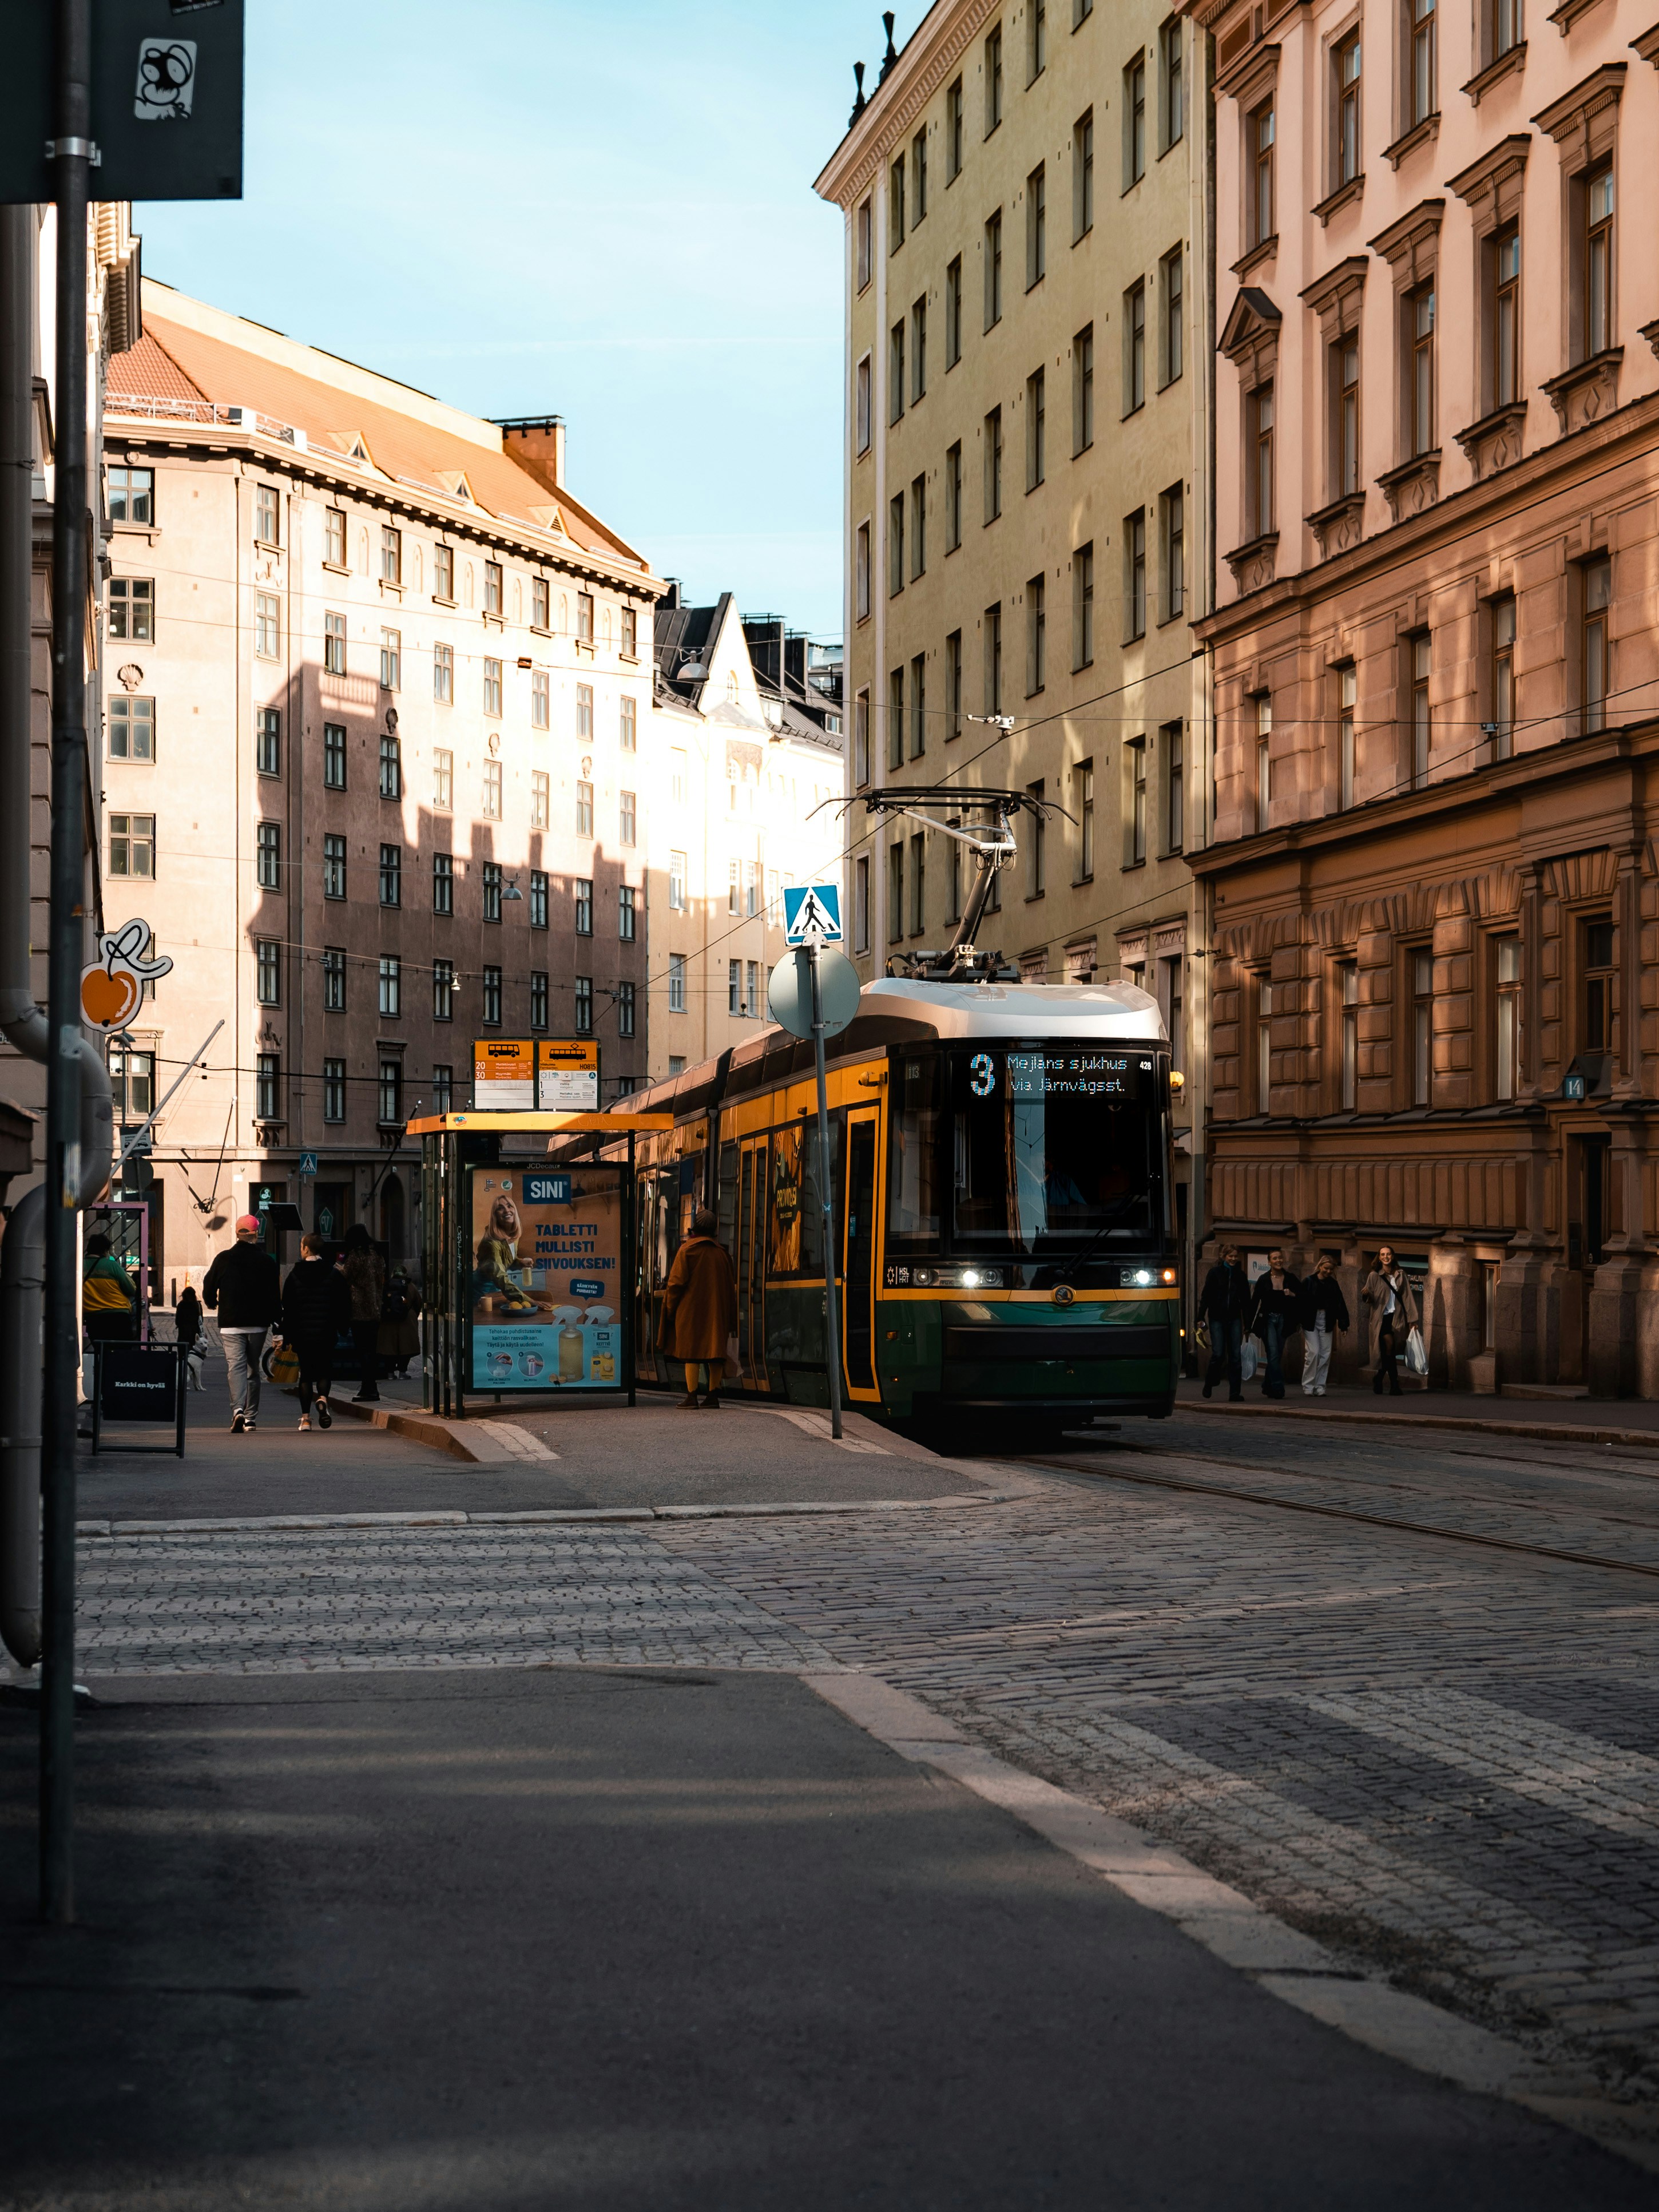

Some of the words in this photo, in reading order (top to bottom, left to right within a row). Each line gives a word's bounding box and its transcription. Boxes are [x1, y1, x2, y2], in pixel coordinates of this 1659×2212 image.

[475, 1061, 486, 1069] 20
[1007, 1056, 1064, 1072] Mejlans
[1070, 1057, 1127, 1072] sjukhus
[1140, 1061, 1152, 1070] 428
[971, 1054, 995, 1095] 3
[1011, 1079, 1032, 1091] via
[1038, 1079, 1125, 1095] Järnvägsst.
[1569, 1080, 1580, 1095] 14
[530, 1181, 562, 1198] SINI
[535, 1224, 597, 1236] TABLETTI
[535, 1241, 594, 1252] MULLISTI
[535, 1258, 615, 1269] SIIVOUKSEN!
